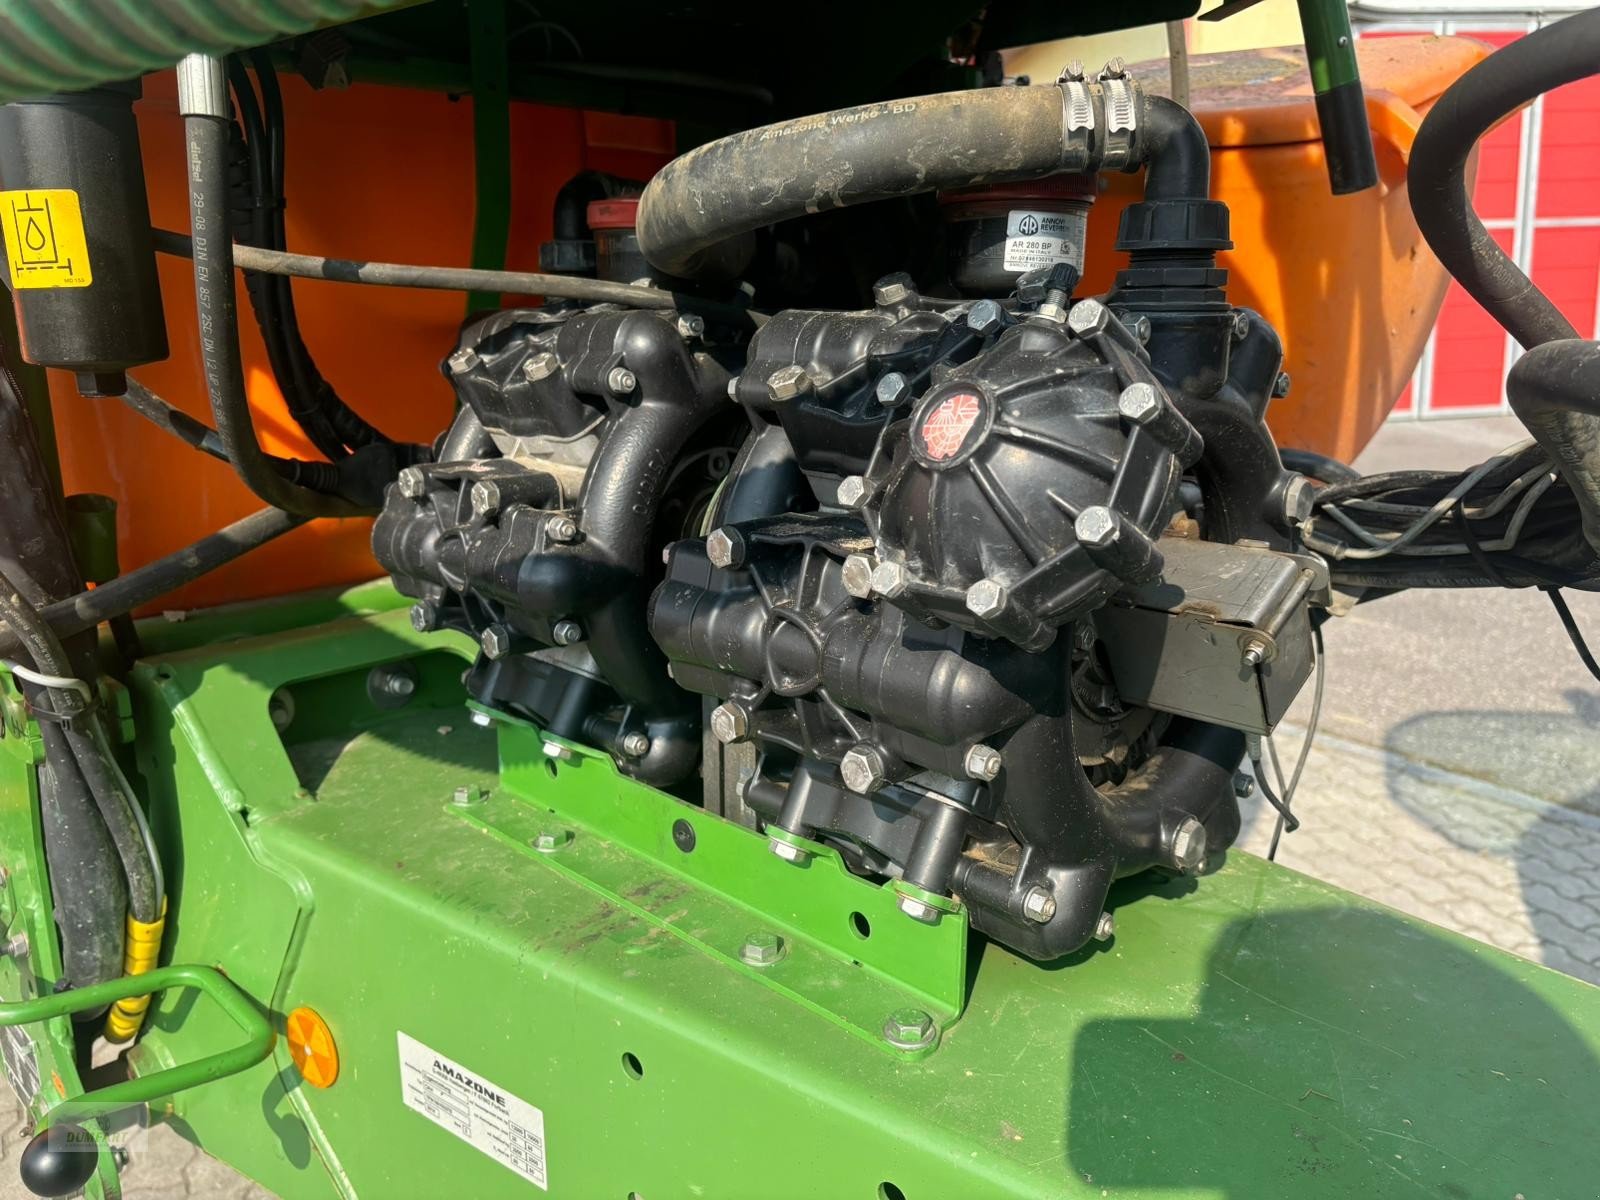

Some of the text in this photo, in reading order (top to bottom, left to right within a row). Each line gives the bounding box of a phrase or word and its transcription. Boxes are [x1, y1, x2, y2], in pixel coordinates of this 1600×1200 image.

[759, 121, 826, 141] Amazone
[830, 110, 879, 125] Werke
[893, 103, 917, 114] BD
[193, 192, 206, 232] 29-08
[196, 236, 209, 261] DIN
[1012, 241, 1052, 250] AR 280 BP
[198, 266, 209, 283] EN
[199, 287, 211, 308] 857
[201, 313, 213, 334] 2SC
[204, 337, 215, 353] DN
[433, 1060, 506, 1107] AMAZONE
